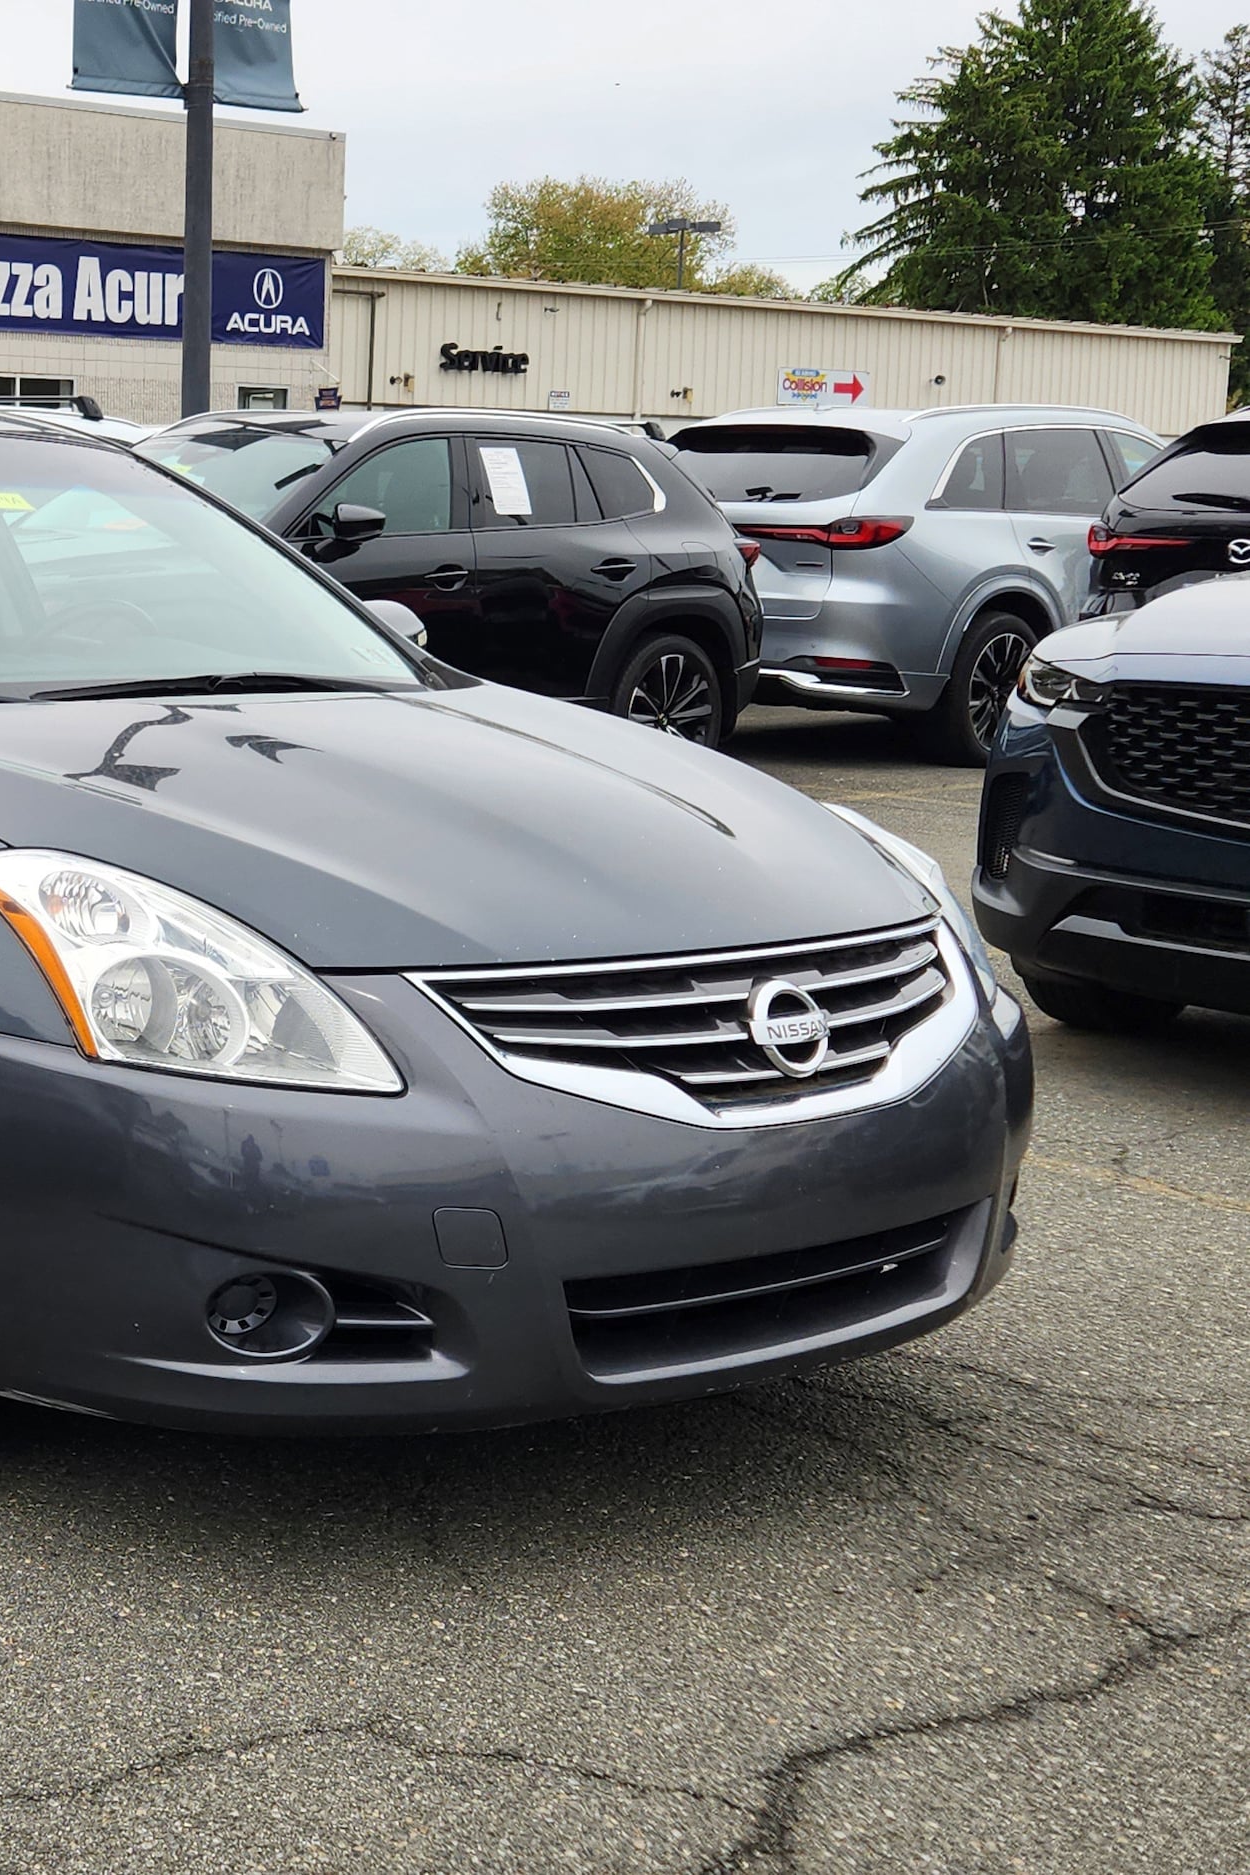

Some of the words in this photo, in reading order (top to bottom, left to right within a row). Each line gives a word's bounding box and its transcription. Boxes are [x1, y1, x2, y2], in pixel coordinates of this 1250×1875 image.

[238, 14, 287, 33] Pre-Owned
[72, 255, 185, 326] Acur
[225, 311, 311, 336] ACURA
[439, 342, 529, 374] Service
[766, 1019, 828, 1040] NISSAN
